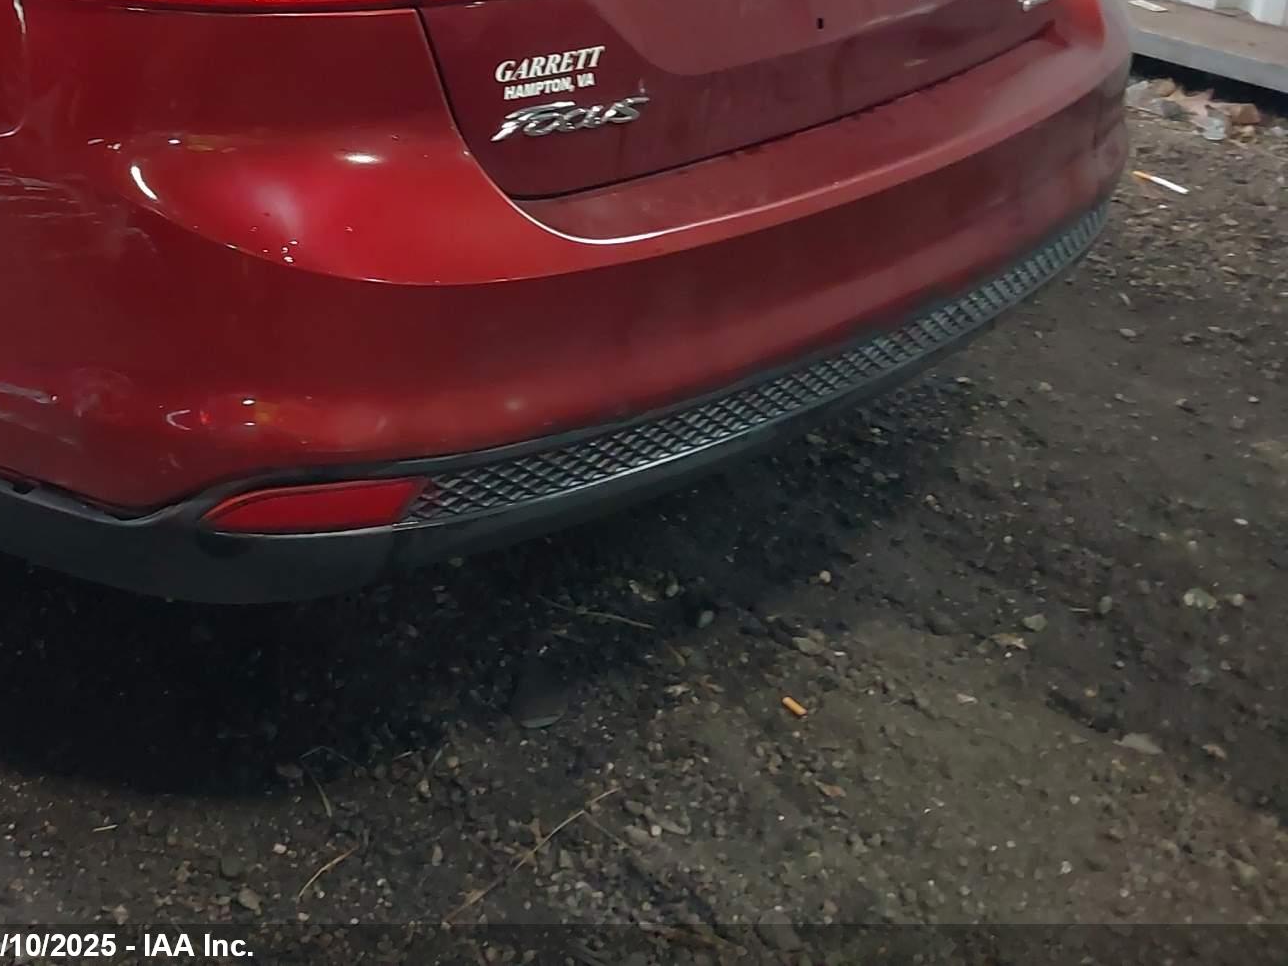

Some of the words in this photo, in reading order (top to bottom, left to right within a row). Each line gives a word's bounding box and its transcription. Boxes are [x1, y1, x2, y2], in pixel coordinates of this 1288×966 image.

[495, 46, 605, 82] GARRETT
[503, 77, 575, 100] HAMPTON,
[576, 72, 595, 87] VA
